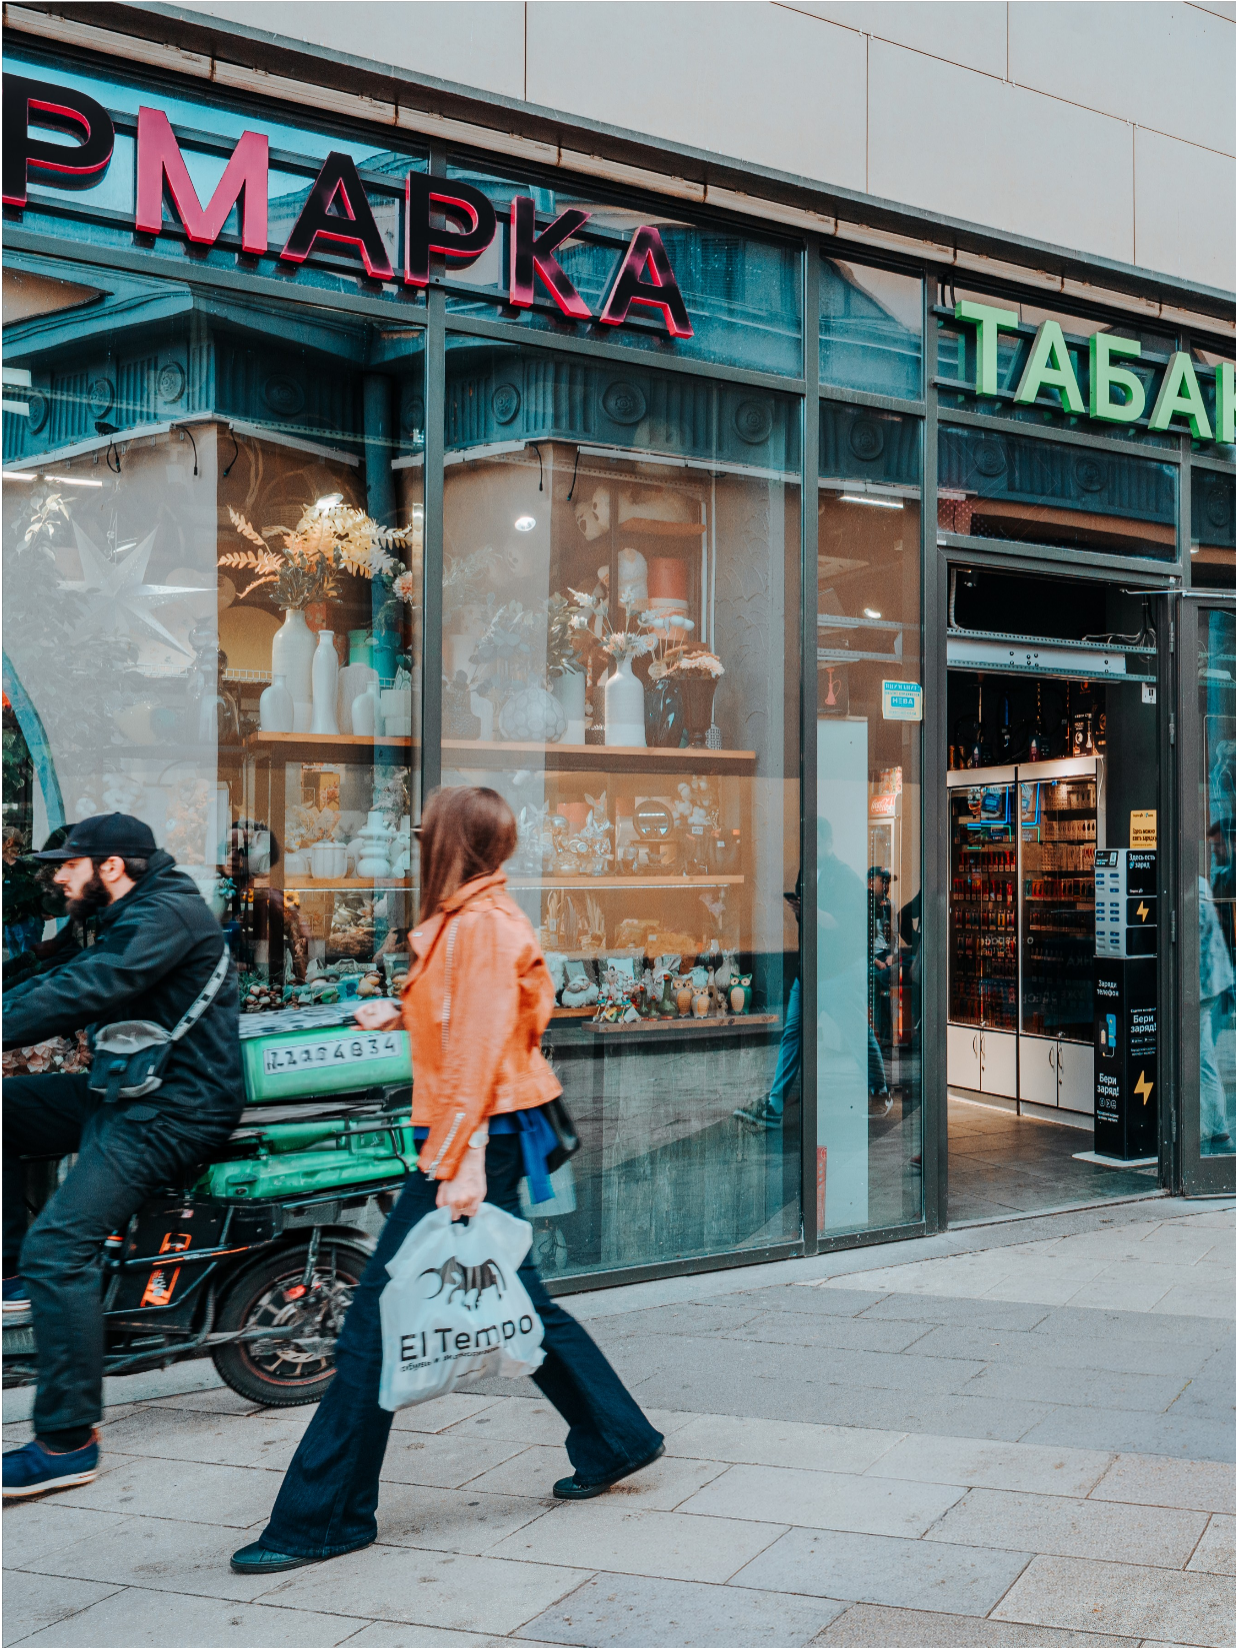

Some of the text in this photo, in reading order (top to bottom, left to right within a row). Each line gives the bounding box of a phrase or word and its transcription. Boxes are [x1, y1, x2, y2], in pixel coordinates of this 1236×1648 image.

[1133, 1014, 1154, 1024] Бери
[1130, 1022, 1157, 1034] заряд!
[1099, 1072, 1117, 1086] Бери
[1096, 1084, 1119, 1097] заряд!
[400, 1314, 533, 1362] El Tempo
